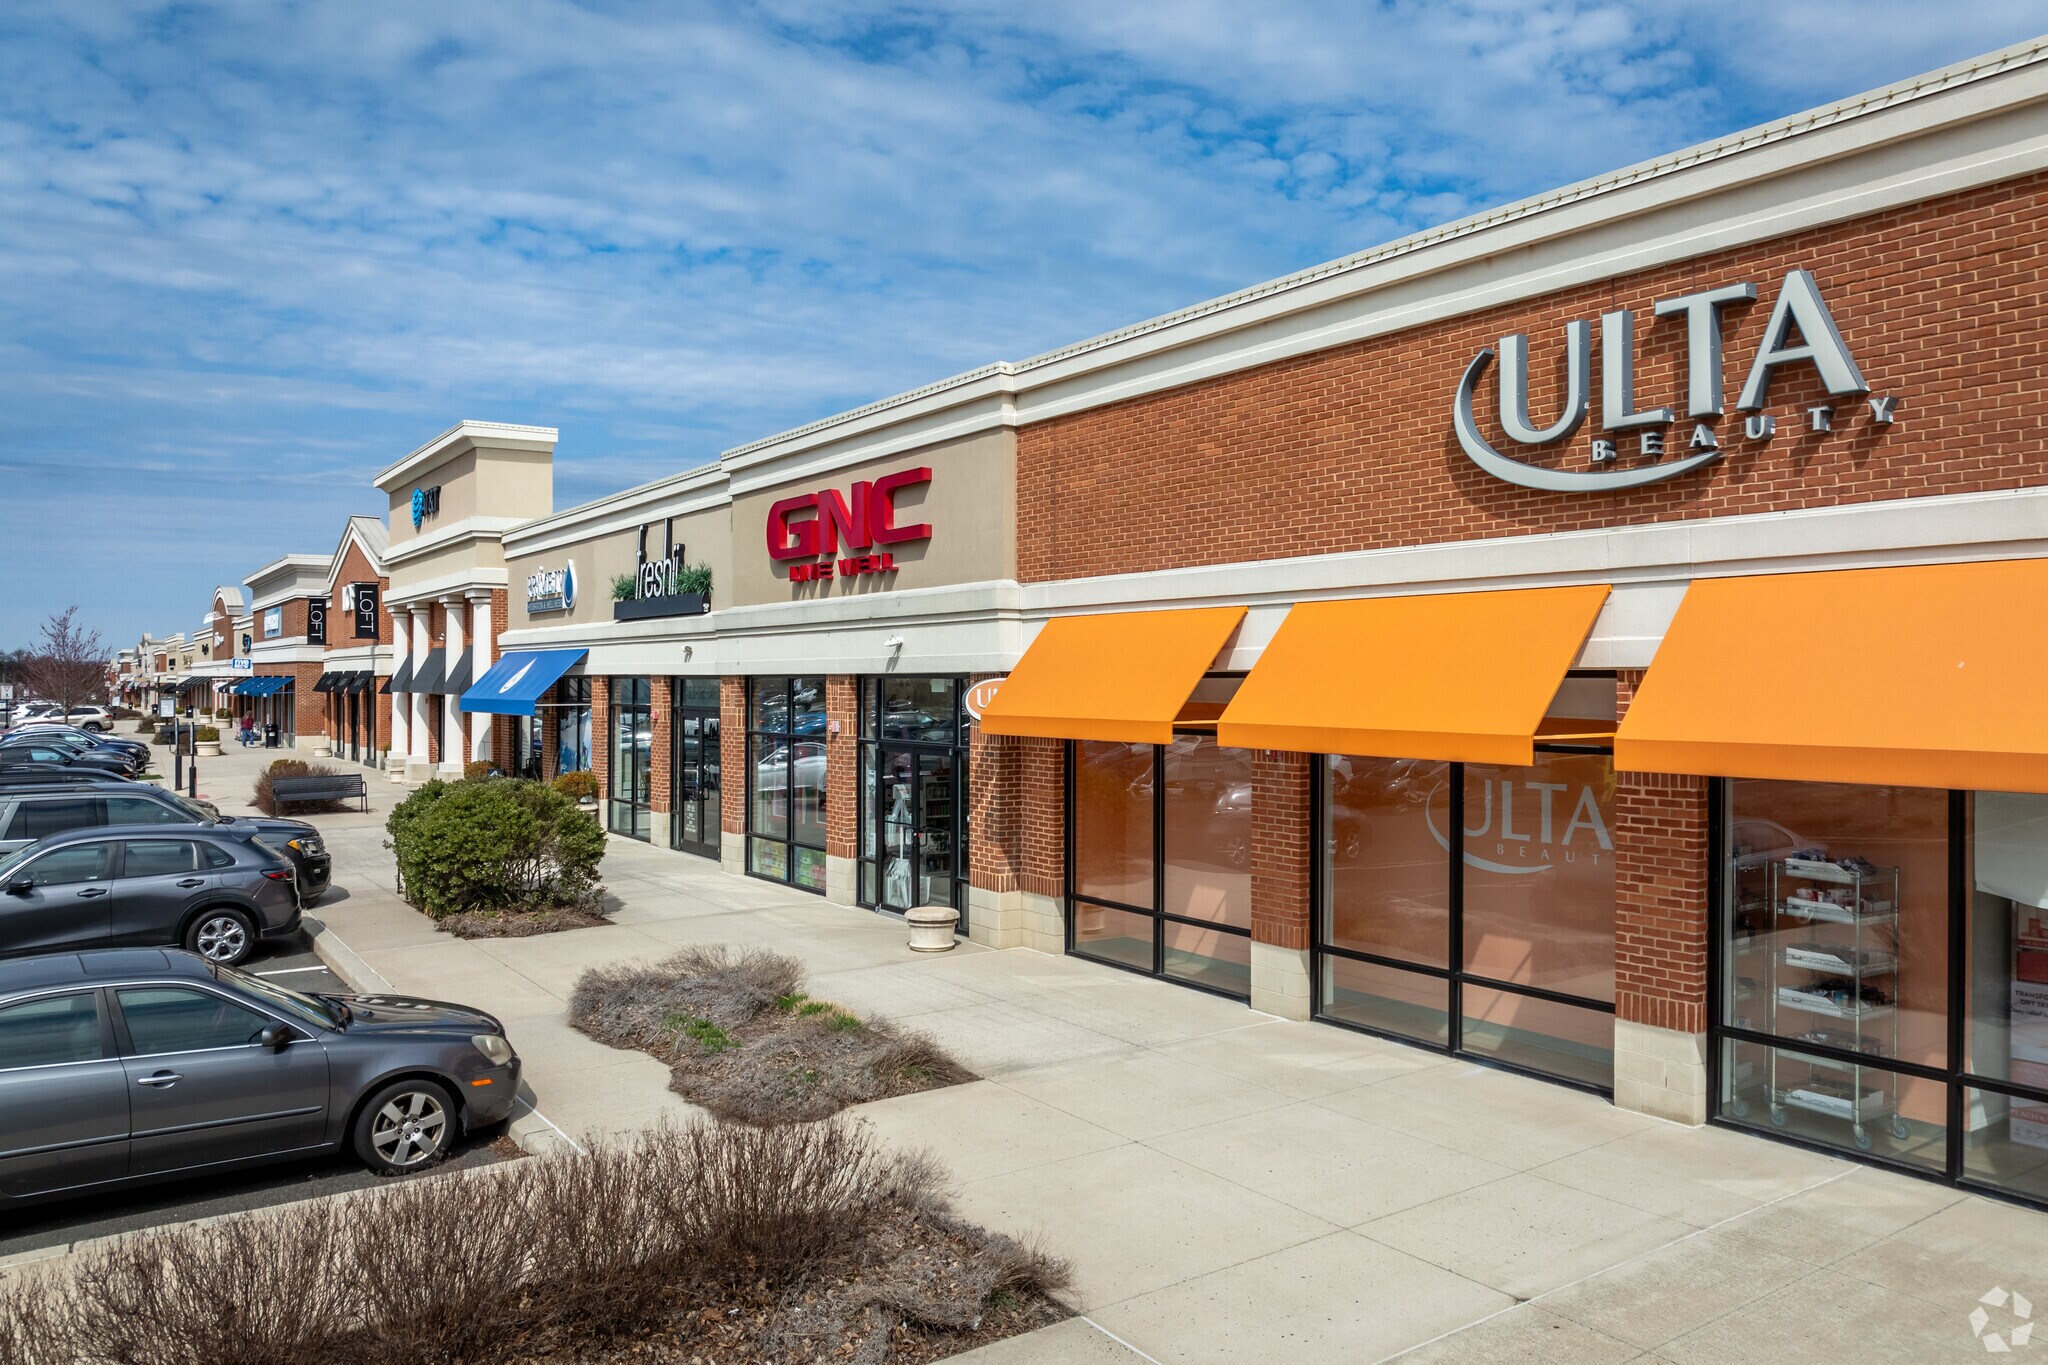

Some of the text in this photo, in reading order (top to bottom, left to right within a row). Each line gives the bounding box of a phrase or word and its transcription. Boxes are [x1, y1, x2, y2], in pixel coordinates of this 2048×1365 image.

[1499, 269, 1870, 445] ULTA
[1591, 395, 1899, 463] BEAUTY
[766, 466, 933, 561] GNC
[635, 518, 683, 600] freshii
[789, 552, 900, 583] LIVE WELL
[310, 603, 323, 640] LOFT
[359, 590, 374, 632] LOFT
[1463, 779, 1614, 850] ULTA
[1496, 843, 1602, 866] BEAUT
